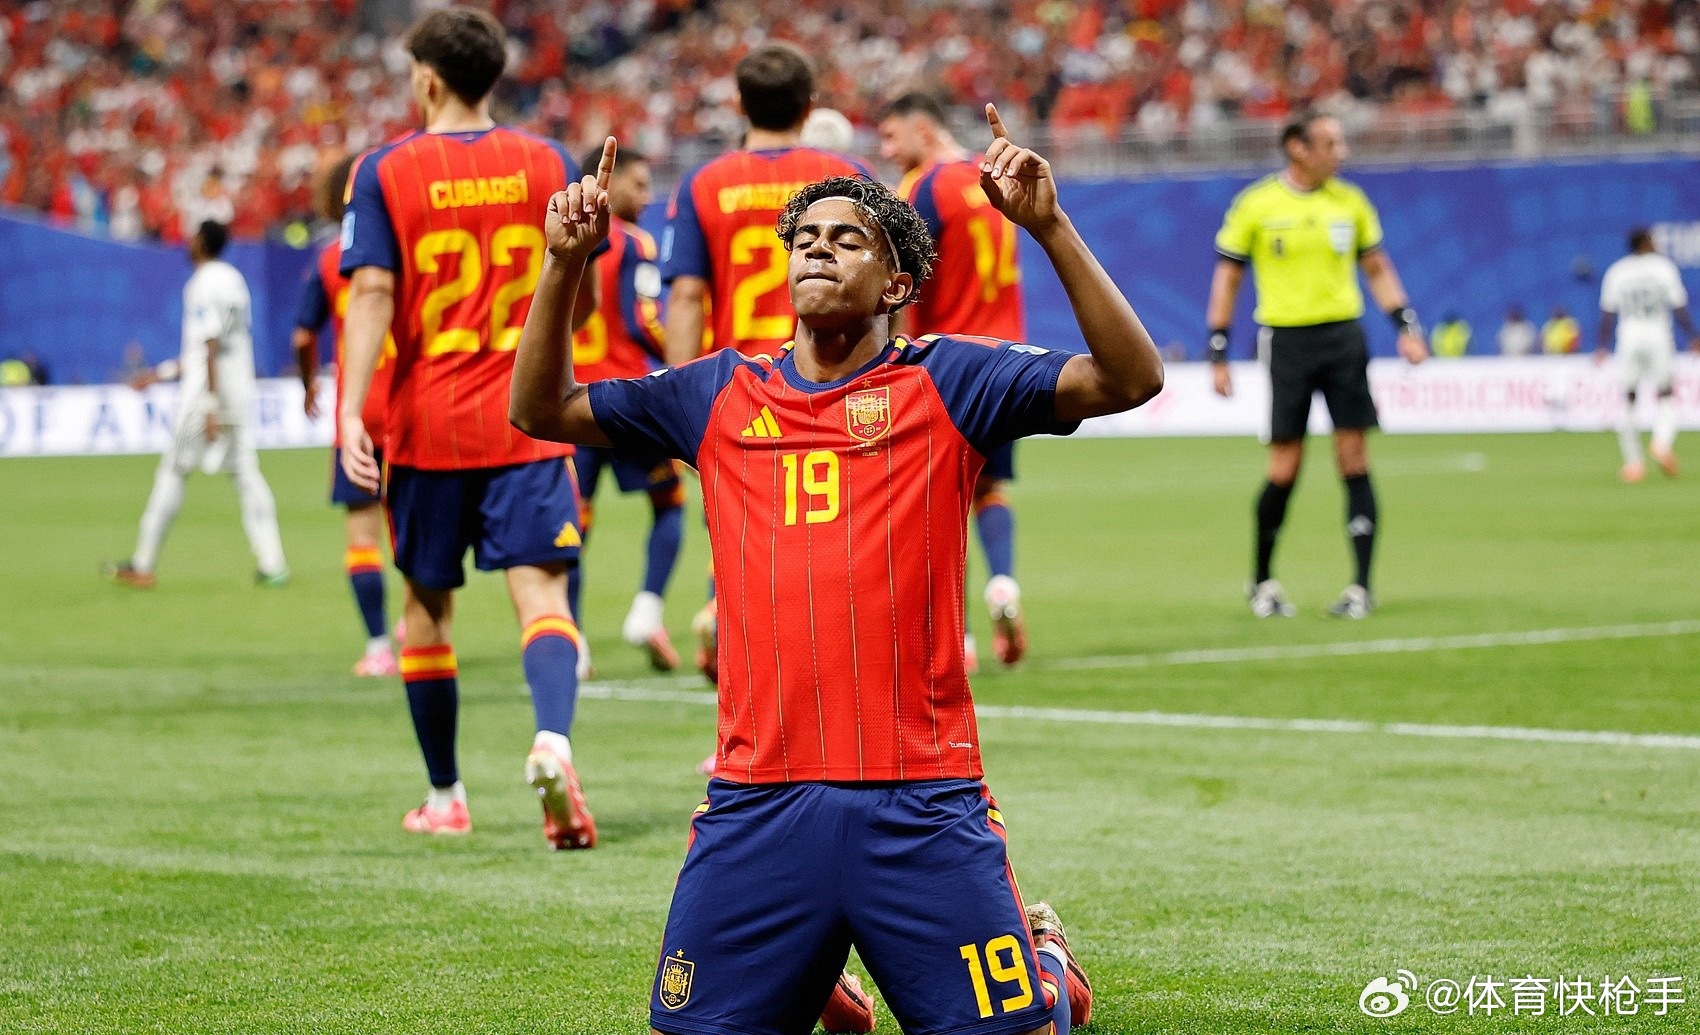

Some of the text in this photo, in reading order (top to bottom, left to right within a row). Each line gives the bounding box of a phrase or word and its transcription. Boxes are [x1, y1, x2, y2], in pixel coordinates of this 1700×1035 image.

[414, 224, 546, 357] 22
[782, 449, 840, 526] 19
[959, 934, 1034, 1018] 19
